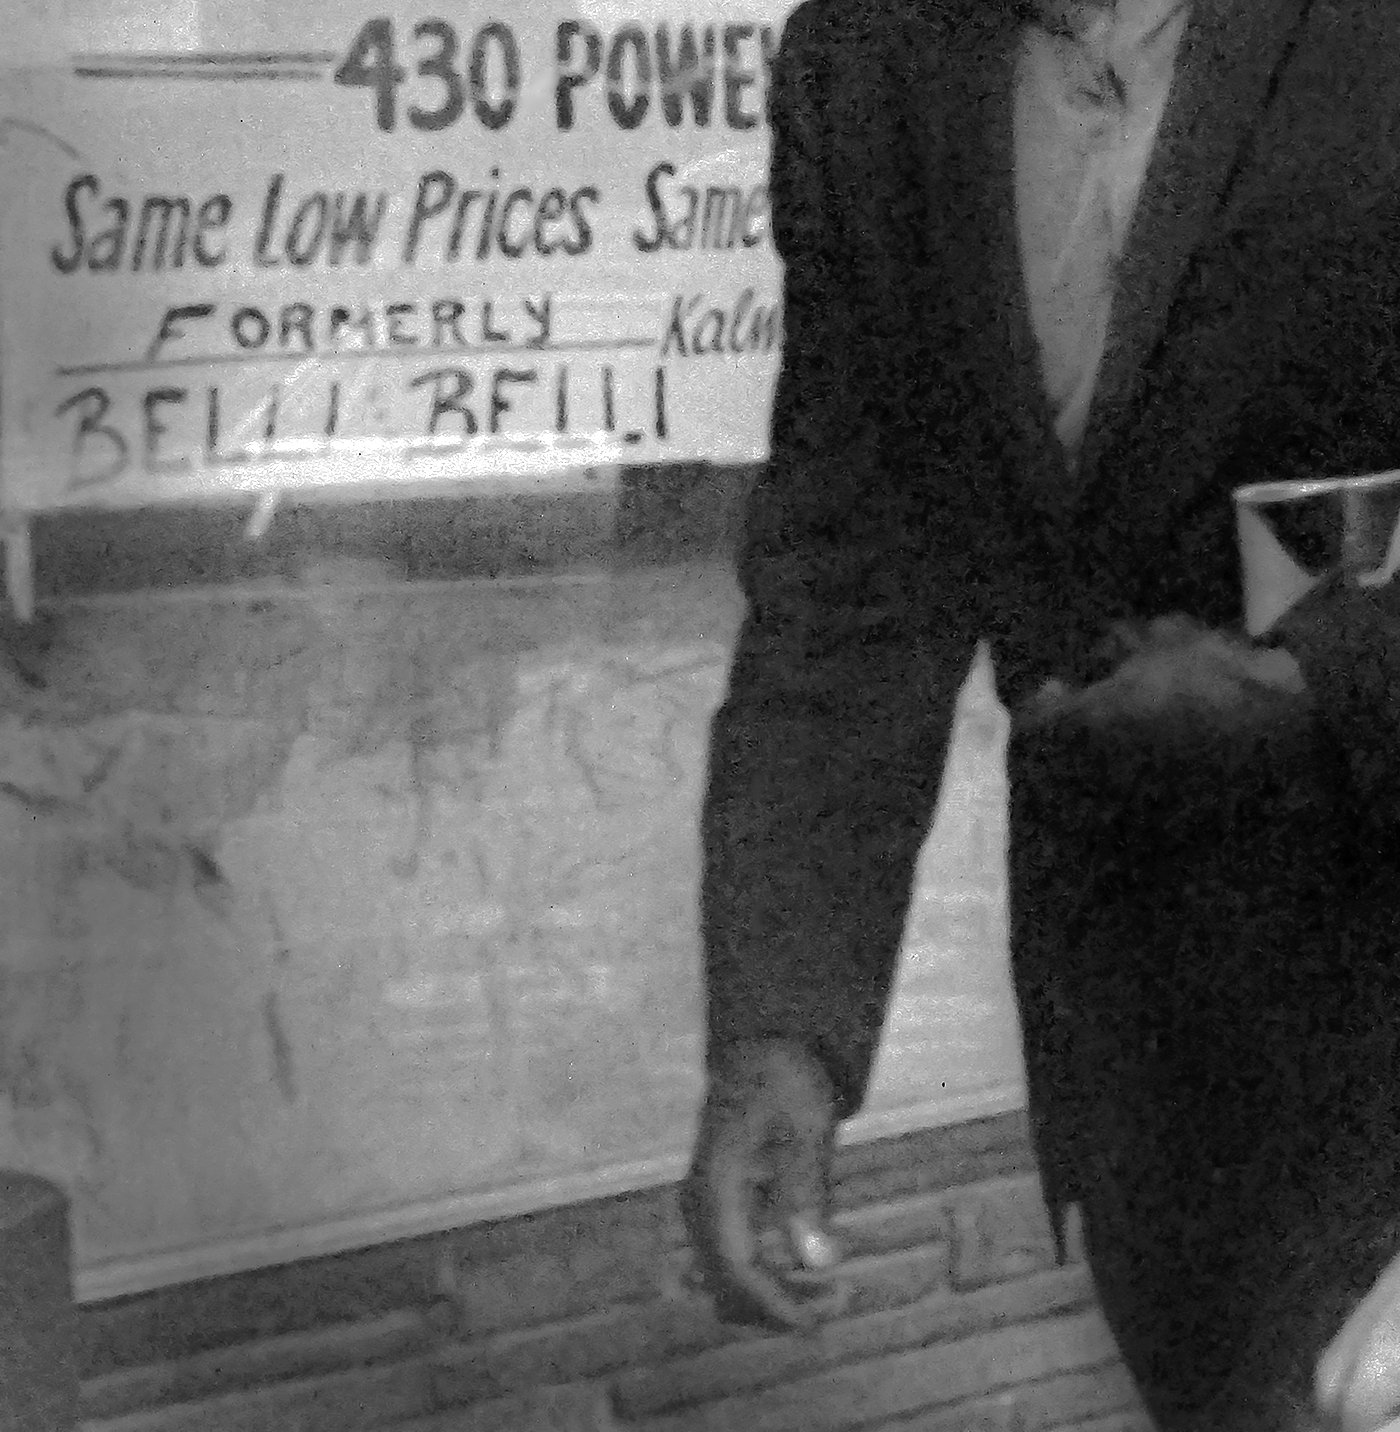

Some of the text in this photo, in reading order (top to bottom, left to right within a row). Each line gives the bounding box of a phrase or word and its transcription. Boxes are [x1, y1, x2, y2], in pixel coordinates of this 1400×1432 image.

[334, 17, 780, 134] 430 POWE
[51, 162, 772, 274] Same Low Prices Same
[146, 292, 554, 363] FORMERLY
